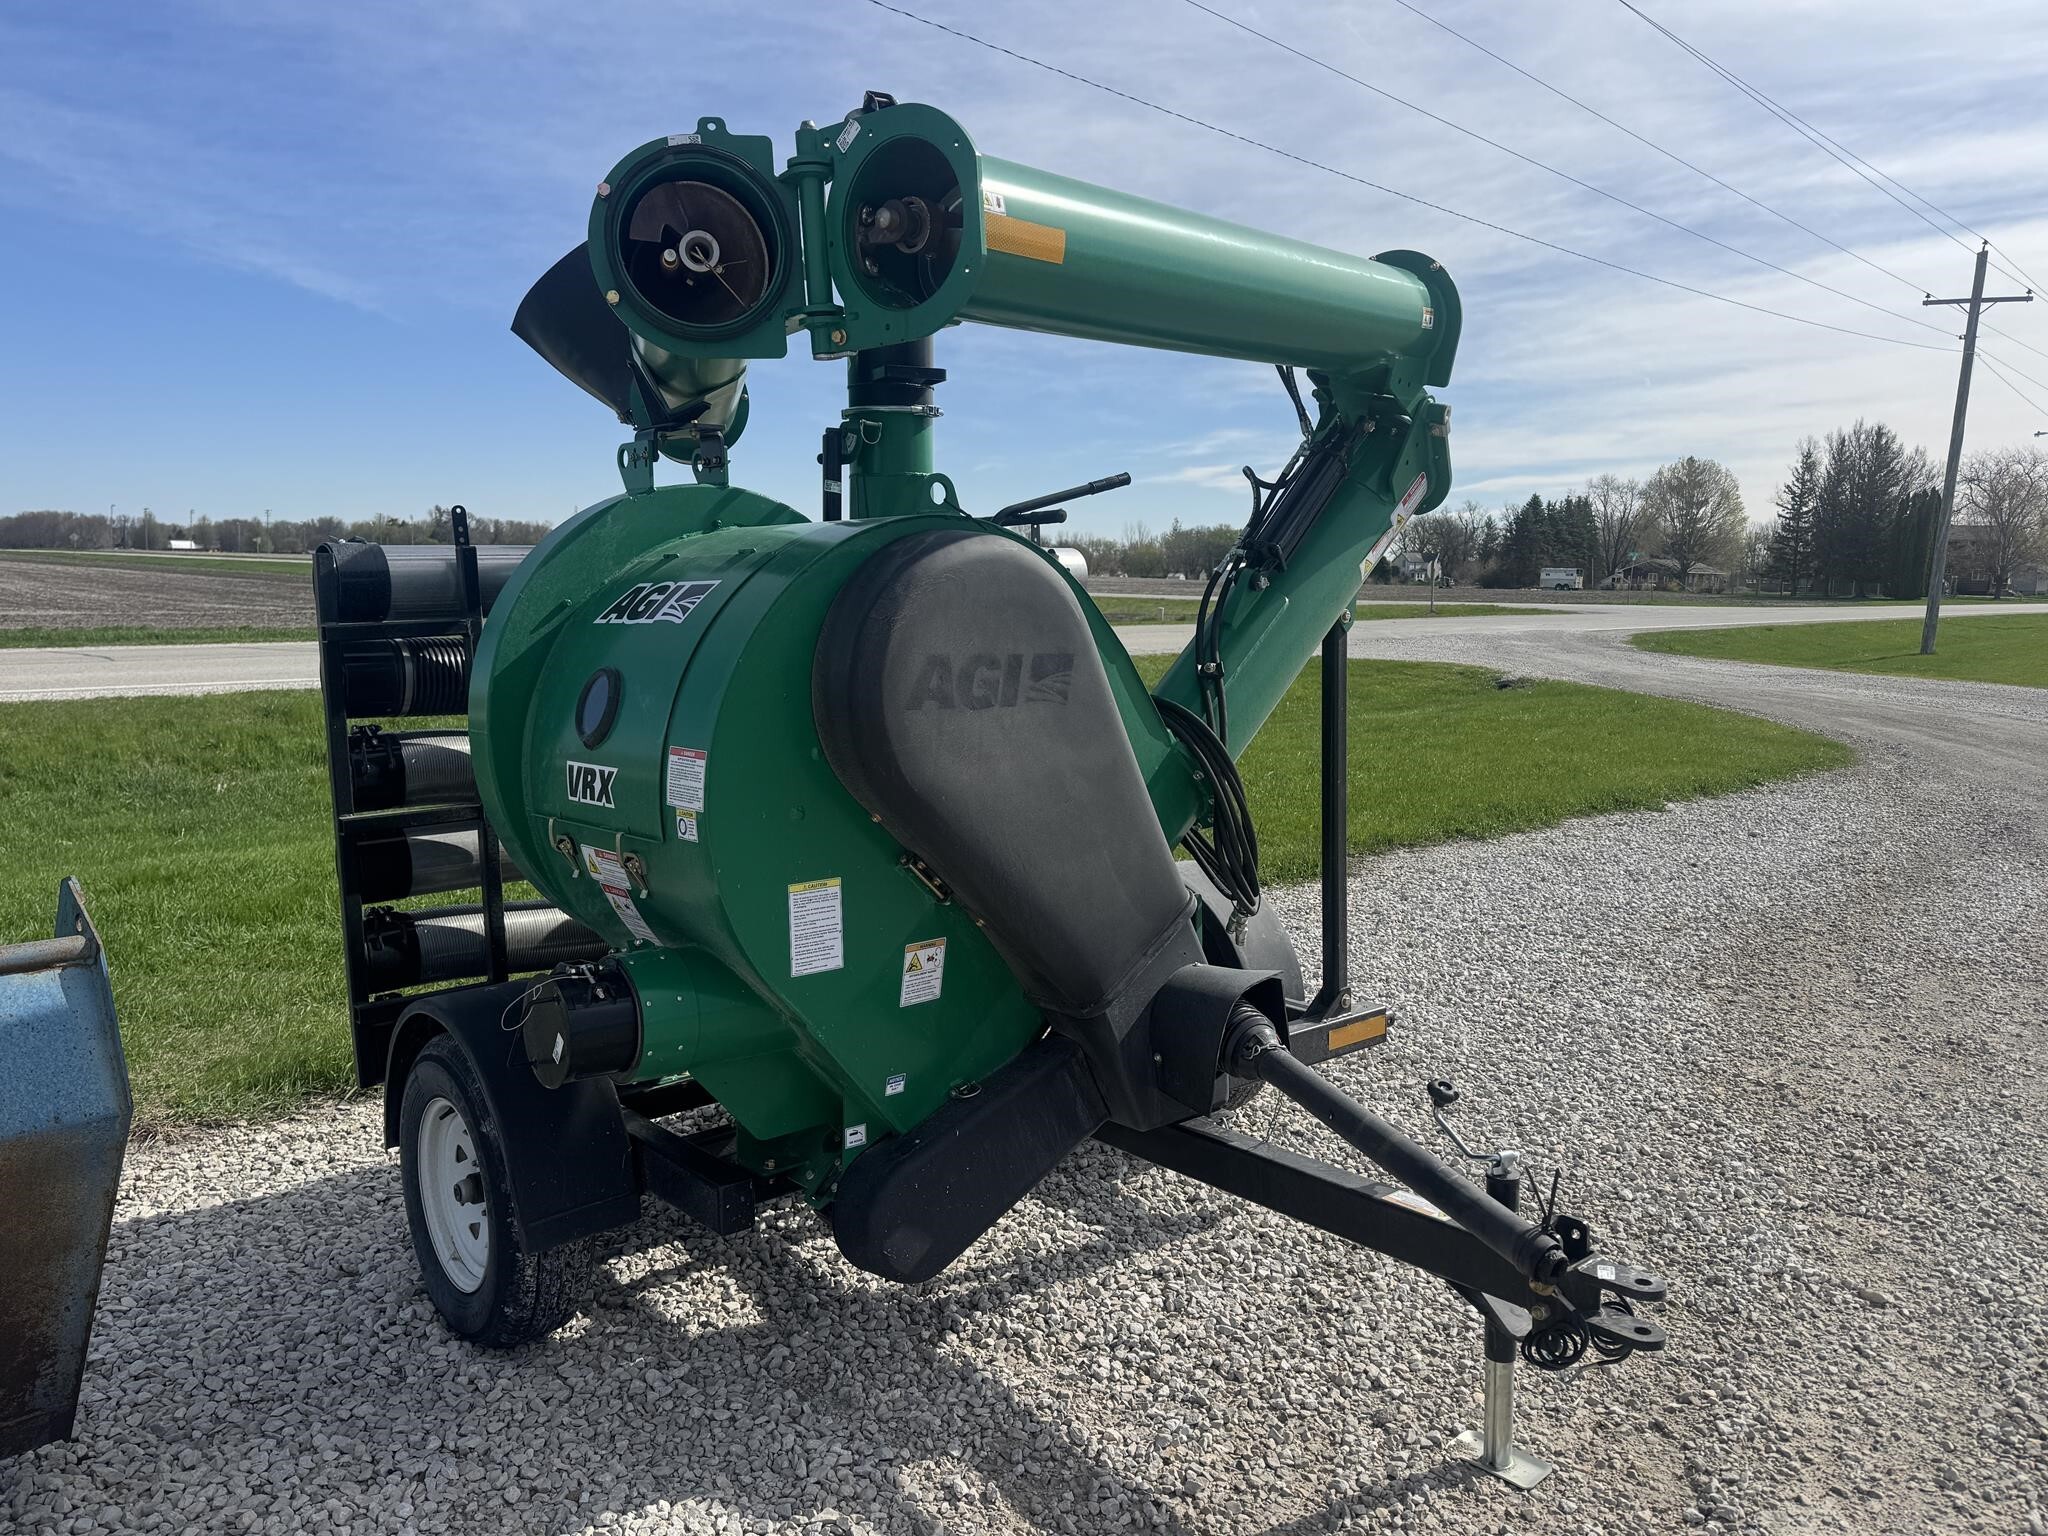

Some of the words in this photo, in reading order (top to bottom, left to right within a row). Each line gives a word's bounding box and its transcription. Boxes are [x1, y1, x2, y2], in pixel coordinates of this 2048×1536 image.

[594, 582, 690, 624] AGI
[904, 653, 1024, 710] AGI
[568, 764, 615, 805] VRX
